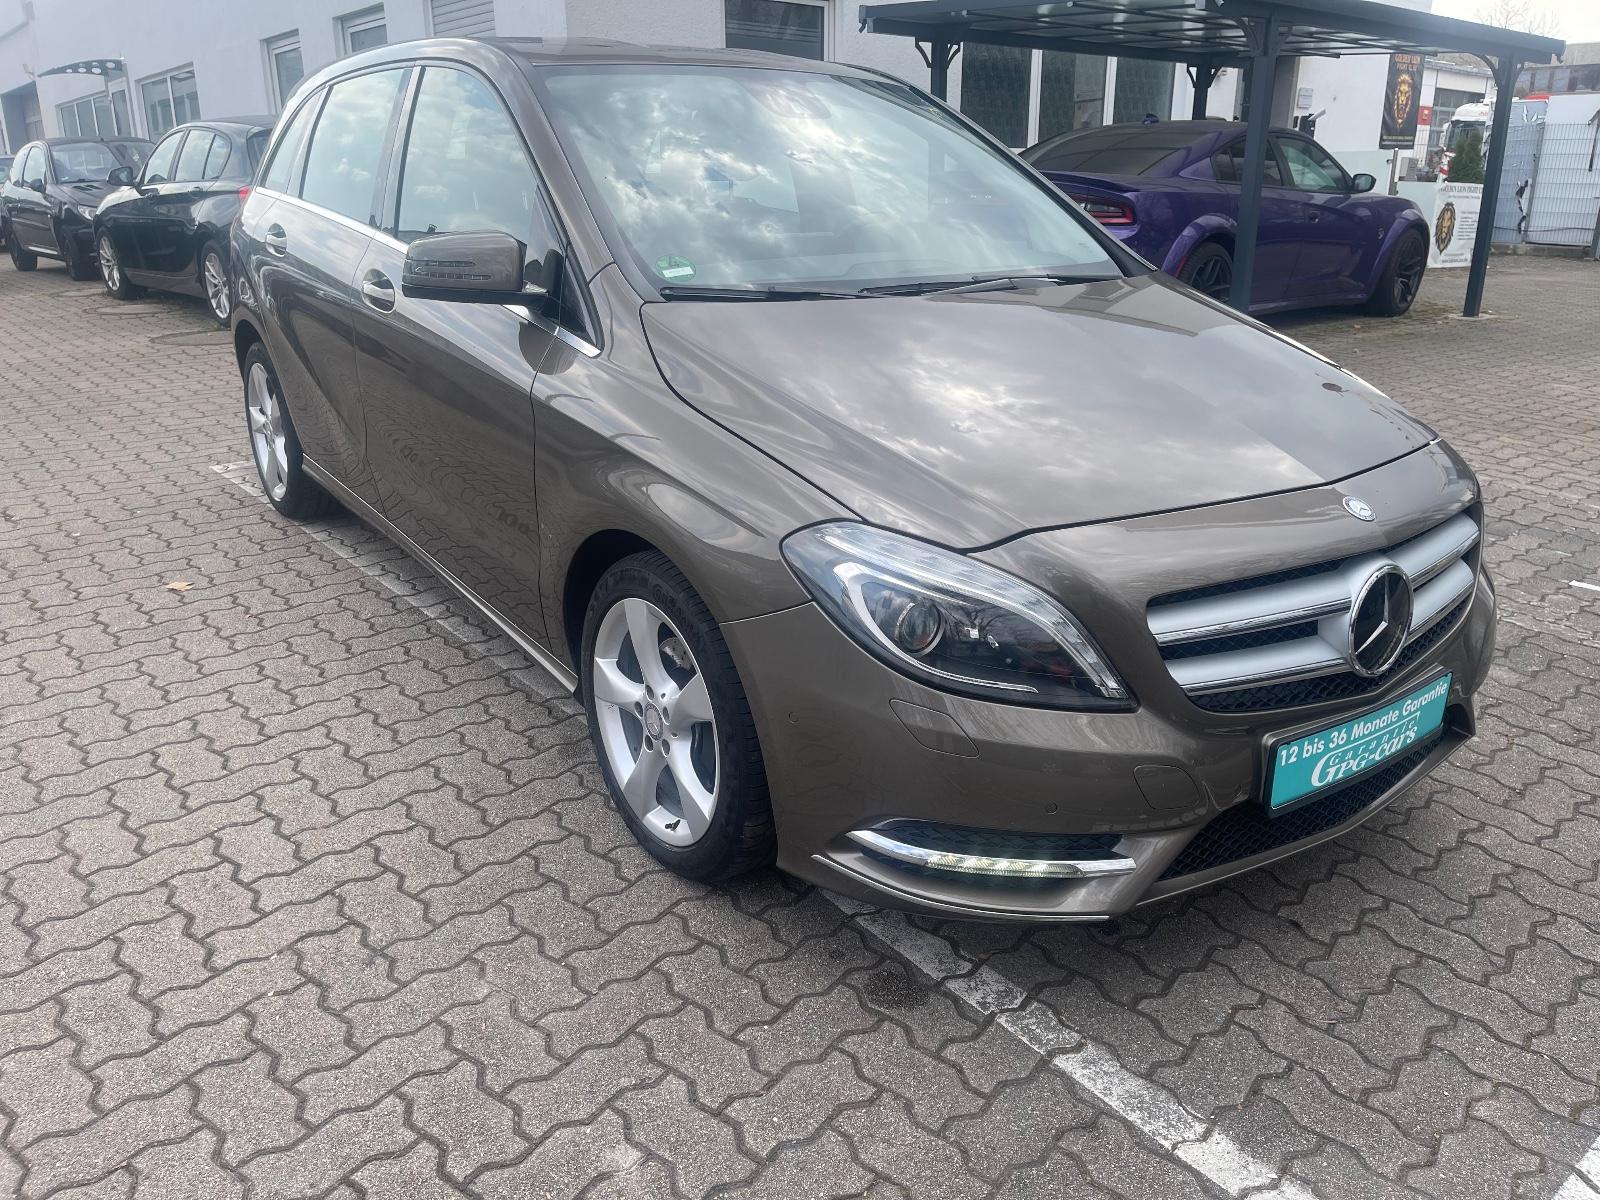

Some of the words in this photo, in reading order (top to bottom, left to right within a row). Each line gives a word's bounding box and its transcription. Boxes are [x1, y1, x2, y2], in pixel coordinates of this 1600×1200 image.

[1280, 745, 1298, 766] 12
[1303, 738, 1325, 758] bis
[1329, 730, 1347, 748] 36
[1350, 709, 1399, 741] Monate
[1402, 682, 1448, 715] Garantie
